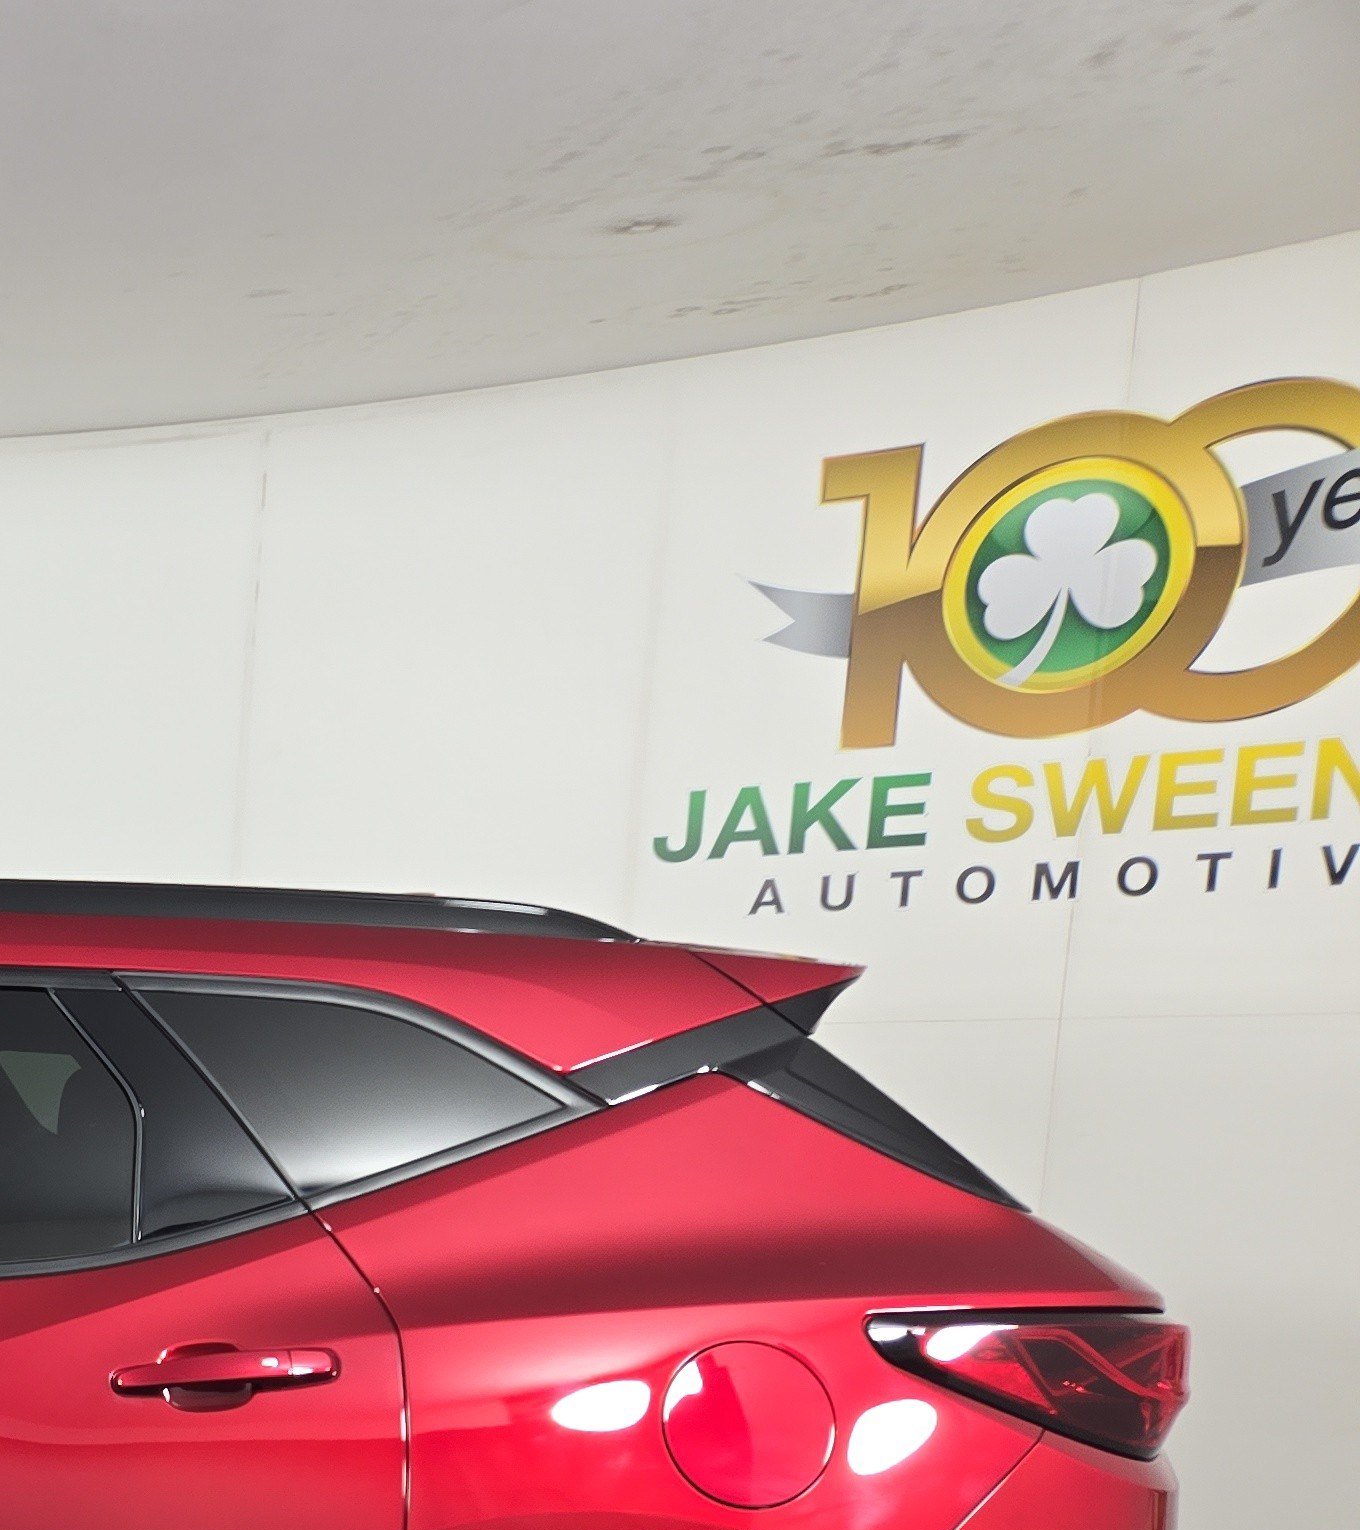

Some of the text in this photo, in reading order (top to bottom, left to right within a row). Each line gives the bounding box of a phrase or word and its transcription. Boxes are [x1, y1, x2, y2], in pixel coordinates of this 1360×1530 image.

[653, 737, 1360, 864] JAKE SWEEN
[747, 842, 1360, 917] AUTOMOTIV
